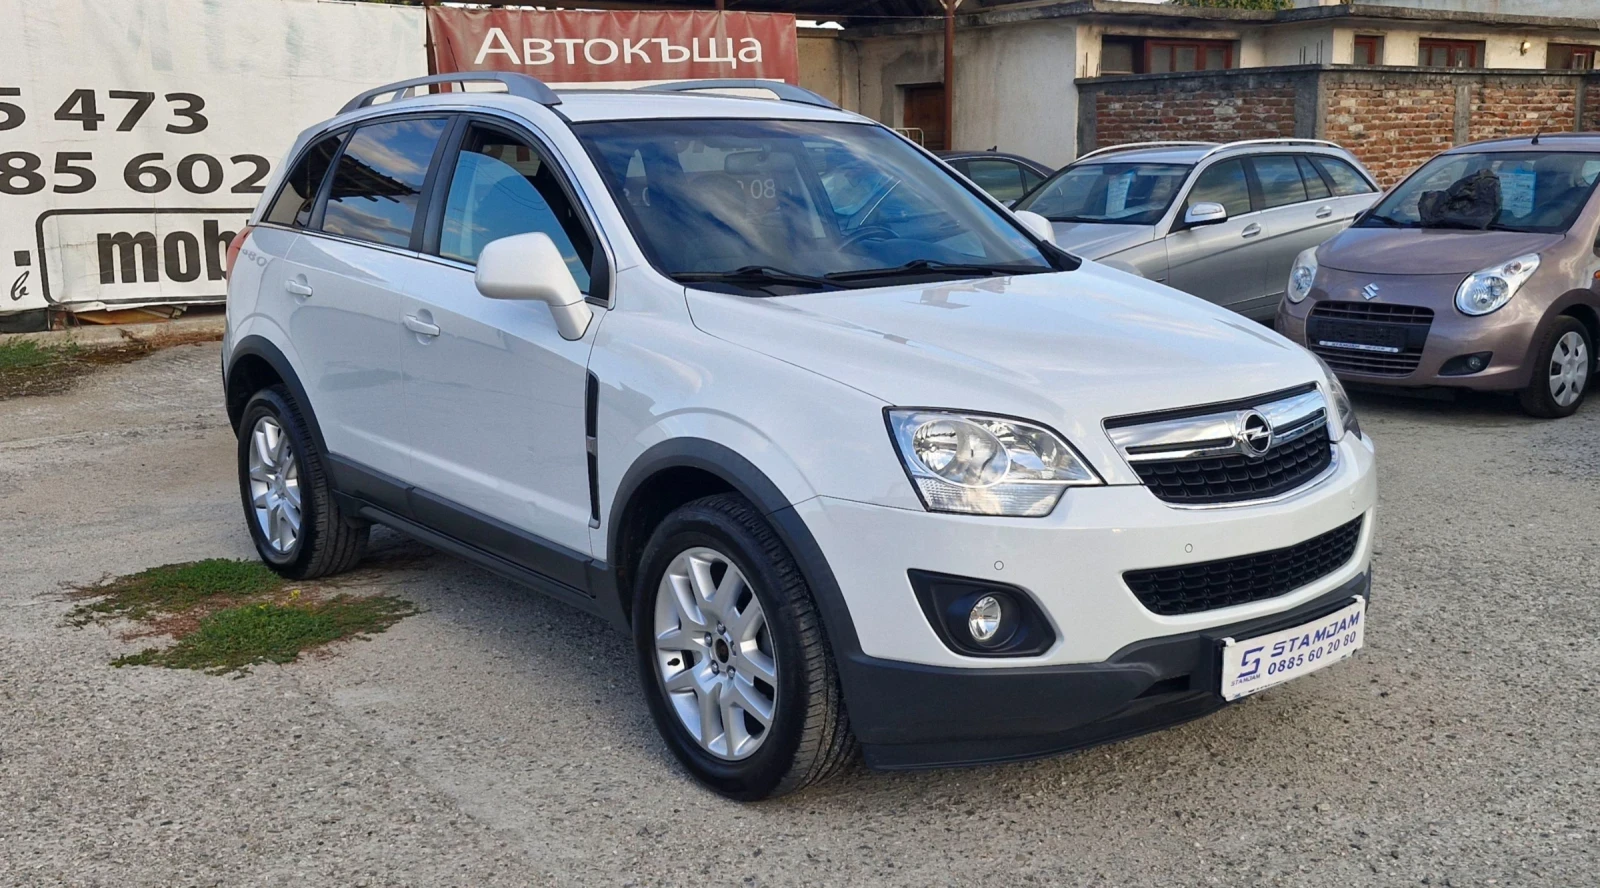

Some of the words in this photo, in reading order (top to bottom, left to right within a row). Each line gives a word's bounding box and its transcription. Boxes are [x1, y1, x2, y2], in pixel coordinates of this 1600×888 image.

[474, 27, 763, 69] Автокъща
[54, 89, 208, 134] 473
[0, 151, 97, 195] 85
[123, 152, 271, 194] 602
[97, 219, 249, 284] mob
[1267, 653, 1304, 675] 0885
[1308, 646, 1323, 662] 60
[1326, 638, 1340, 655] 20
[1343, 630, 1357, 647] 80
